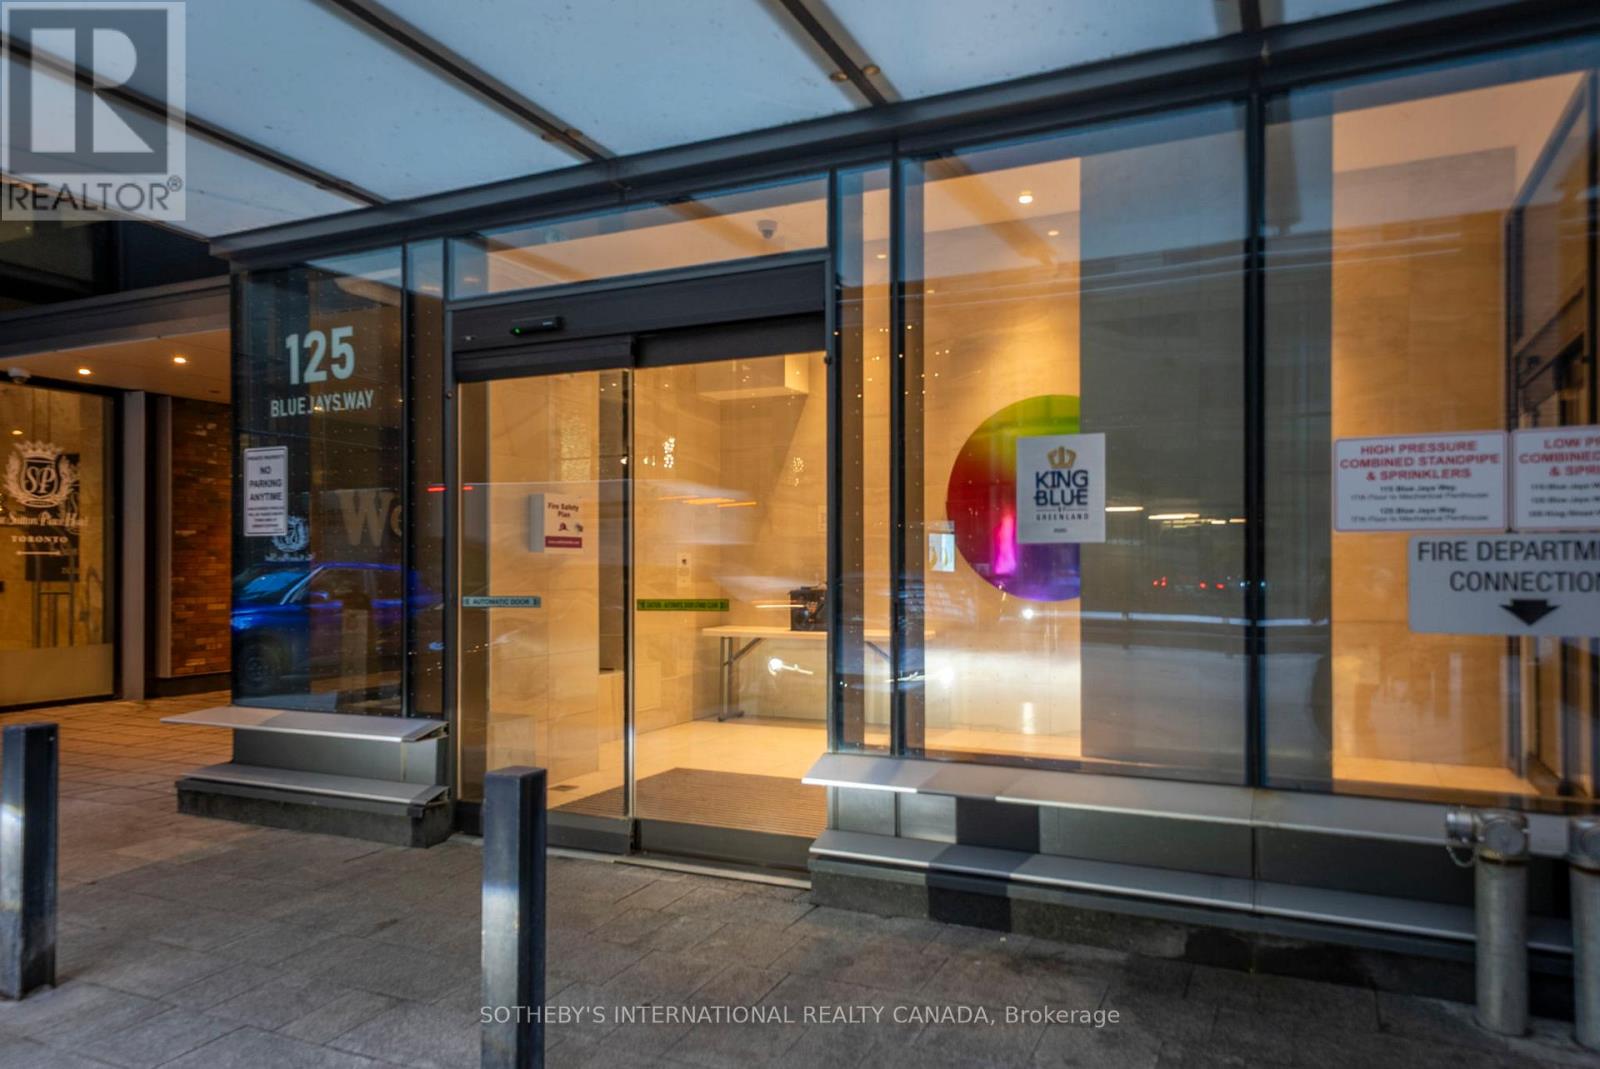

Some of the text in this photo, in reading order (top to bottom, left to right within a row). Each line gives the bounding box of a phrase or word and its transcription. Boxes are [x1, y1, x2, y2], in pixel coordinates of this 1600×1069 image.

[285, 326, 355, 385] 125
[270, 390, 374, 417] BLUE JAYS WAY
[1361, 440, 1478, 455] HIGH PRESSURE
[1544, 438, 1580, 449] LOW
[1340, 453, 1500, 469] COMBINED STANDPIPE
[259, 466, 272, 475] NO
[1366, 468, 1472, 481] & SPRINKLERS
[1549, 466, 1560, 477] &
[249, 479, 283, 489] PARKING
[1035, 469, 1089, 489] KING
[250, 491, 283, 502] ANYTIME
[1033, 488, 1089, 506] BLUE
[11, 535, 69, 543] TORONTO
[1417, 540, 1468, 561] FIRE
